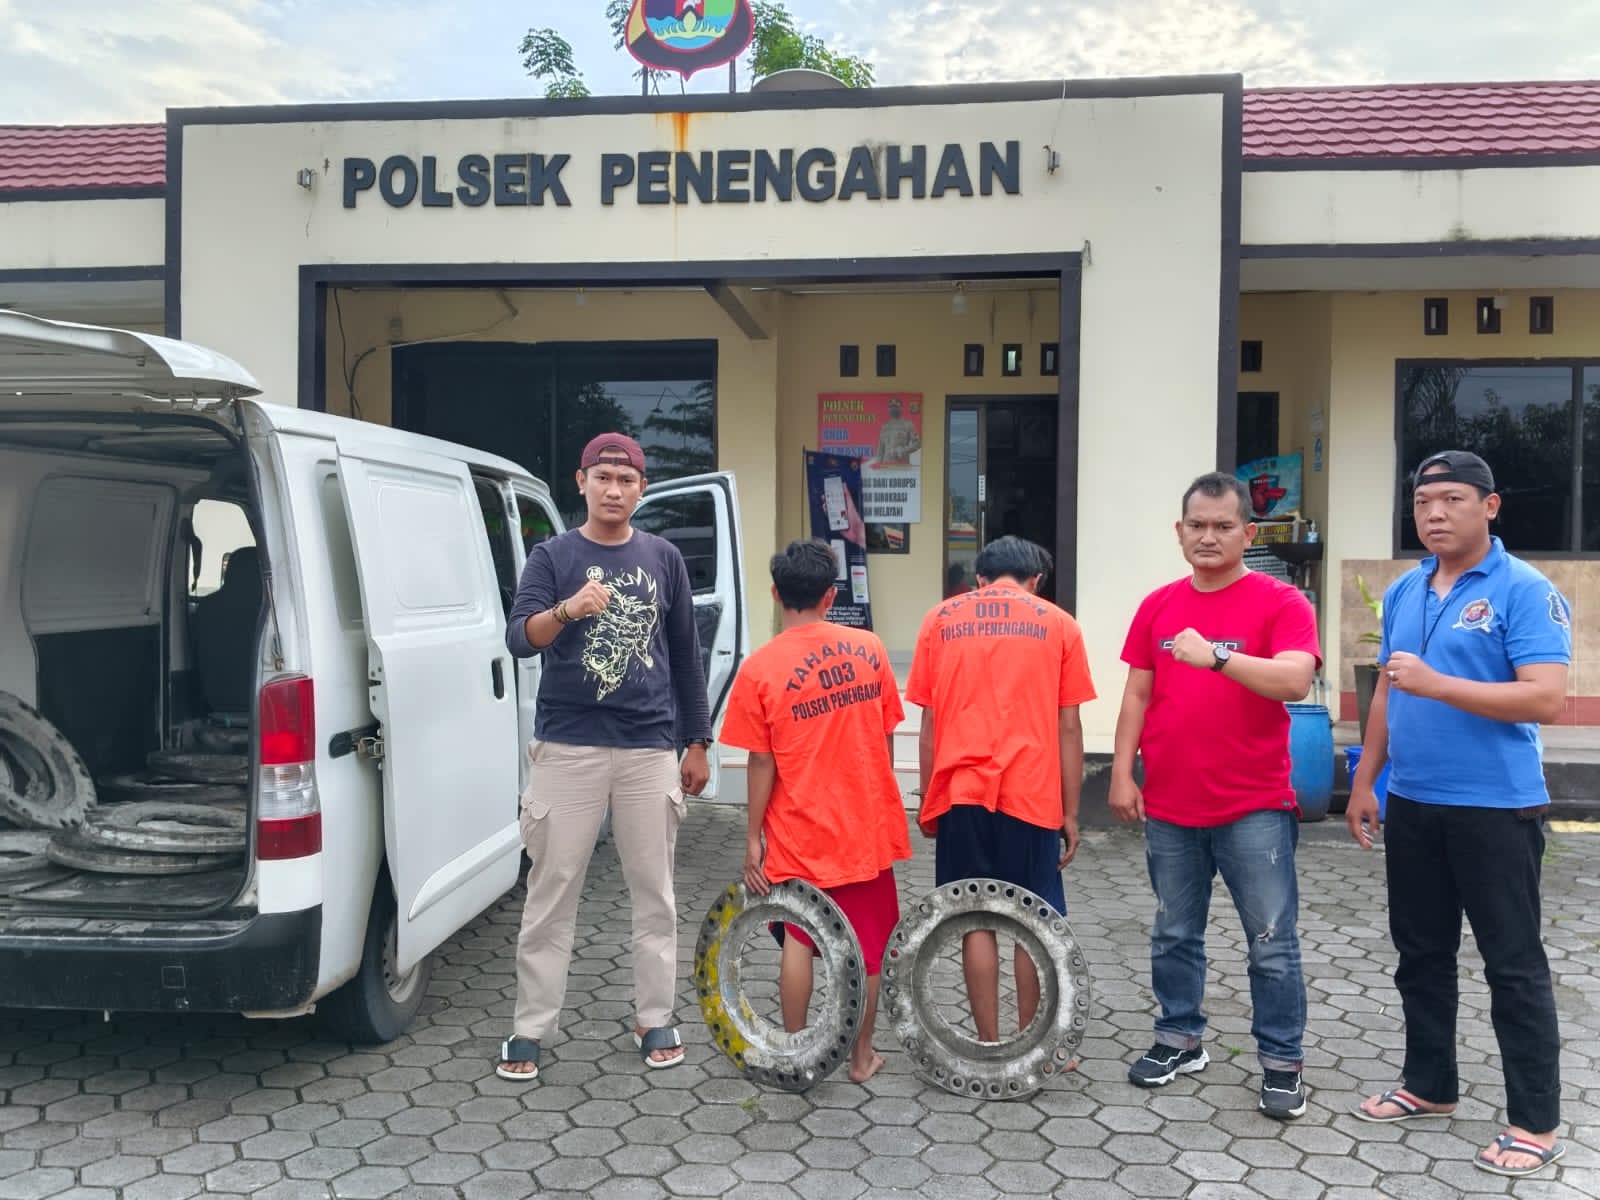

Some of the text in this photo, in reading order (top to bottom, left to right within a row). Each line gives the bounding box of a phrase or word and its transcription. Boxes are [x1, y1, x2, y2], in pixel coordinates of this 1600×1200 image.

[342, 140, 1020, 209] POLSEK PENENGAHAN
[889, 478, 916, 488] KORUPSI
[874, 492, 908, 503] BIROKRASI
[874, 507, 903, 517] MELAYANI
[975, 602, 1010, 618] 001
[941, 620, 1047, 641] POLSEK PENENGAHAN
[786, 641, 881, 692] TAHANAN
[818, 662, 856, 690] 003
[791, 681, 882, 722] POLSEK PENENGAHAN
